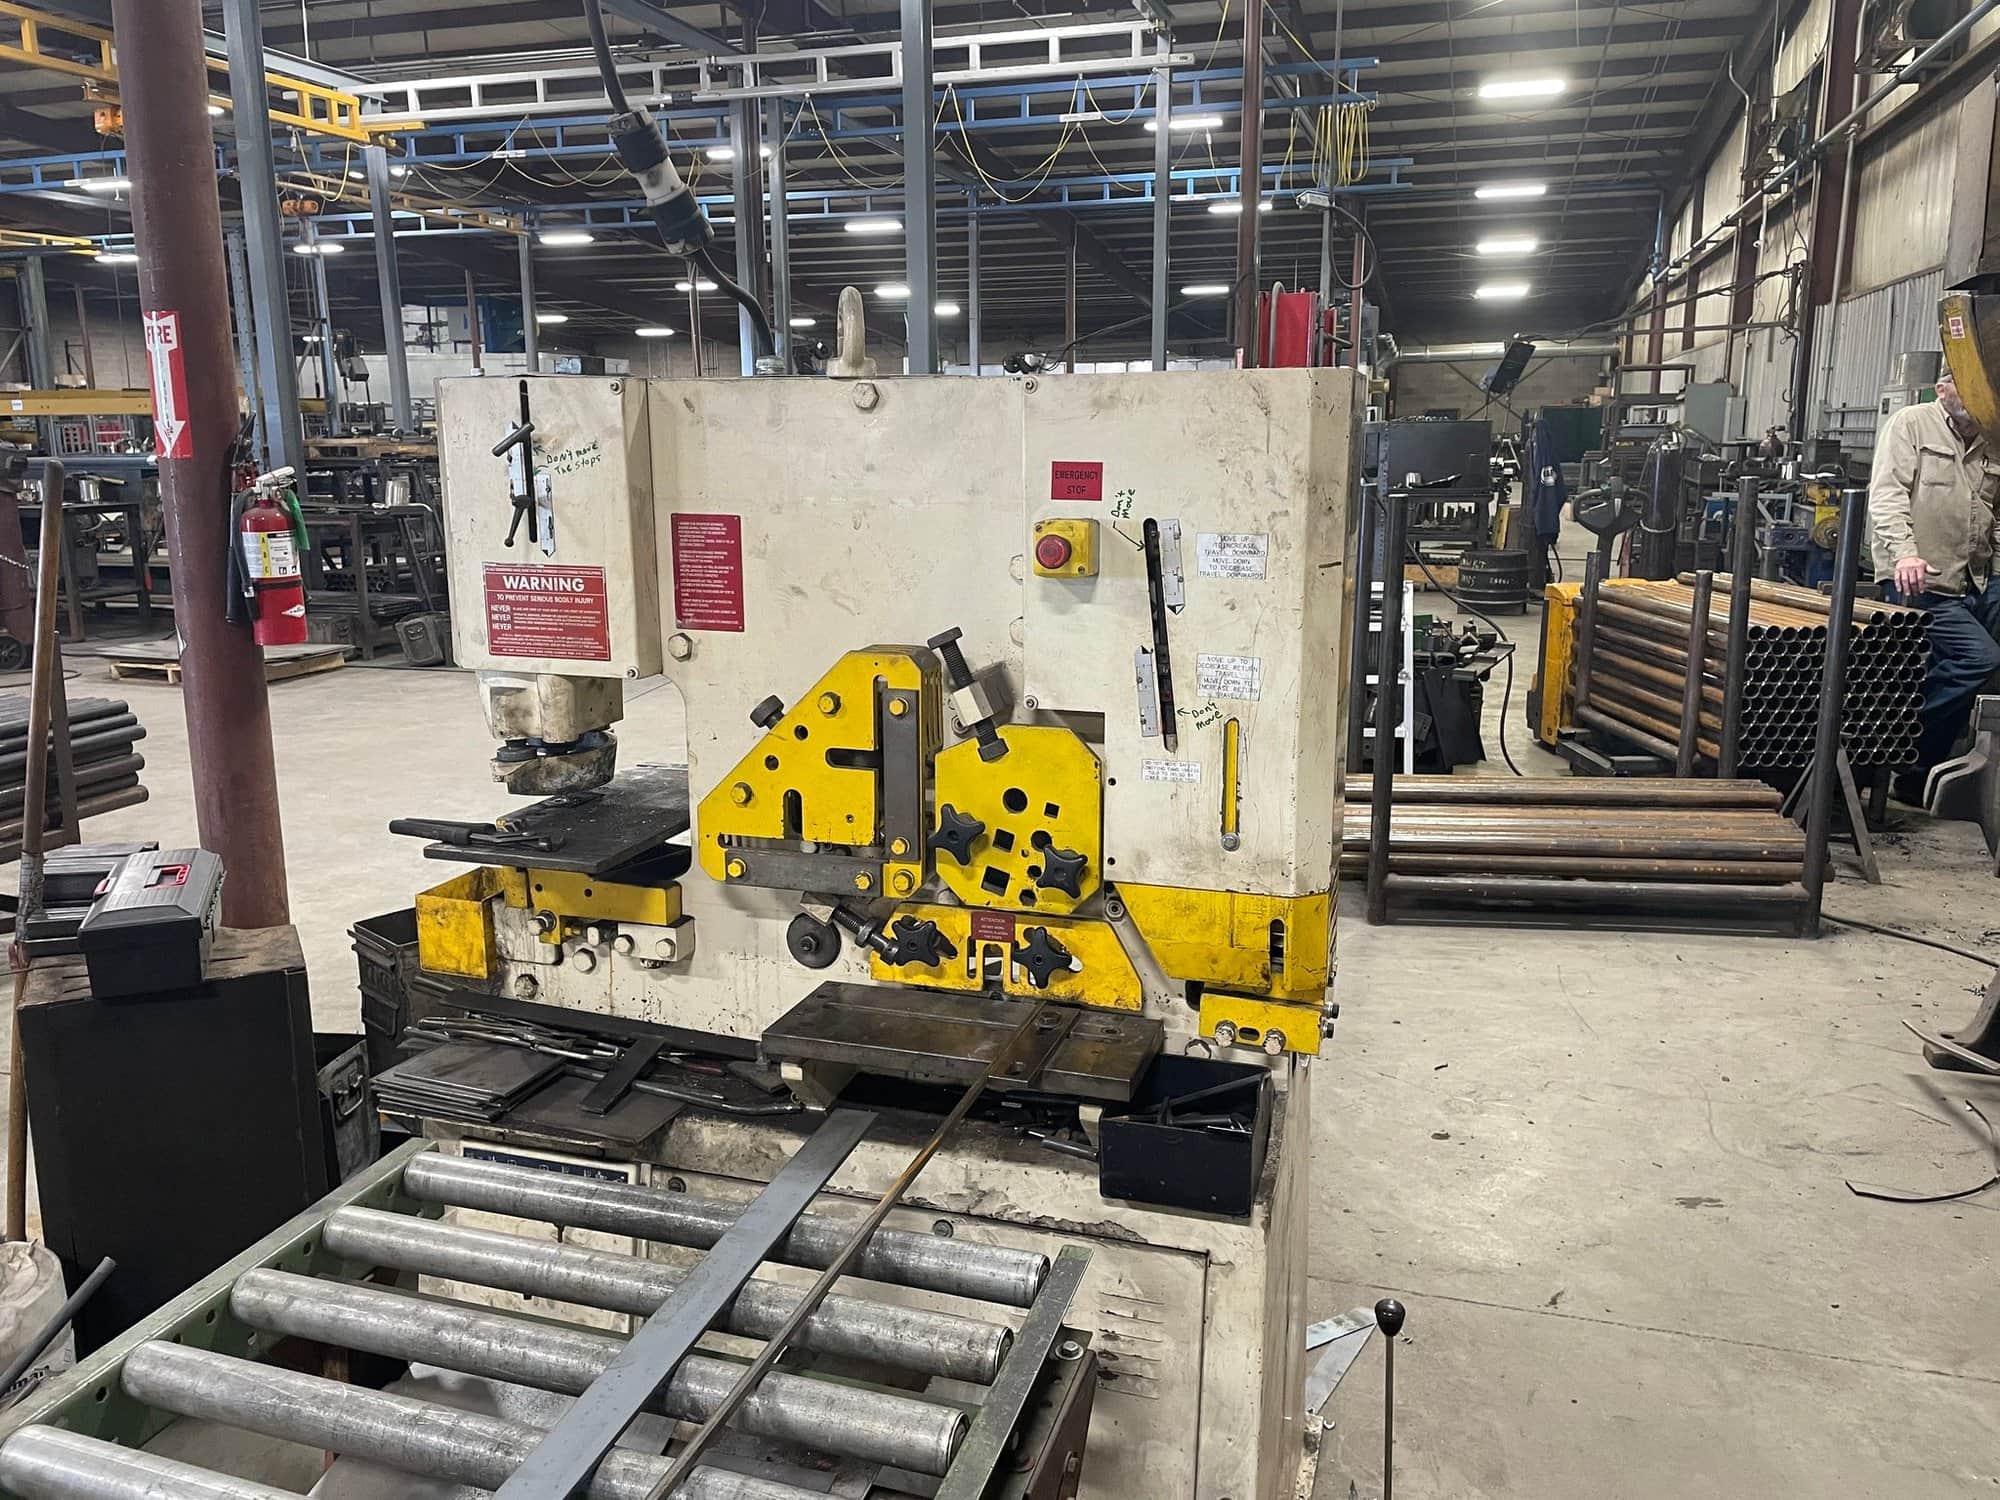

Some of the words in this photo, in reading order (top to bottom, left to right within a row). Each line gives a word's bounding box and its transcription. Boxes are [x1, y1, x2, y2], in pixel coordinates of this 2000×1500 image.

[146, 325, 173, 345] FIRE
[1055, 470, 1098, 480] EMERGENCY
[1066, 484, 1087, 495] STOP
[502, 575, 585, 592] WARNING
[496, 593, 505, 601] TO
[505, 594, 529, 602] PREVENT
[530, 595, 554, 603] SERIOUS
[574, 597, 594, 605] INJURY
[490, 604, 511, 612] NEVER
[491, 613, 512, 621] NEVER
[492, 622, 513, 631] NEVER
